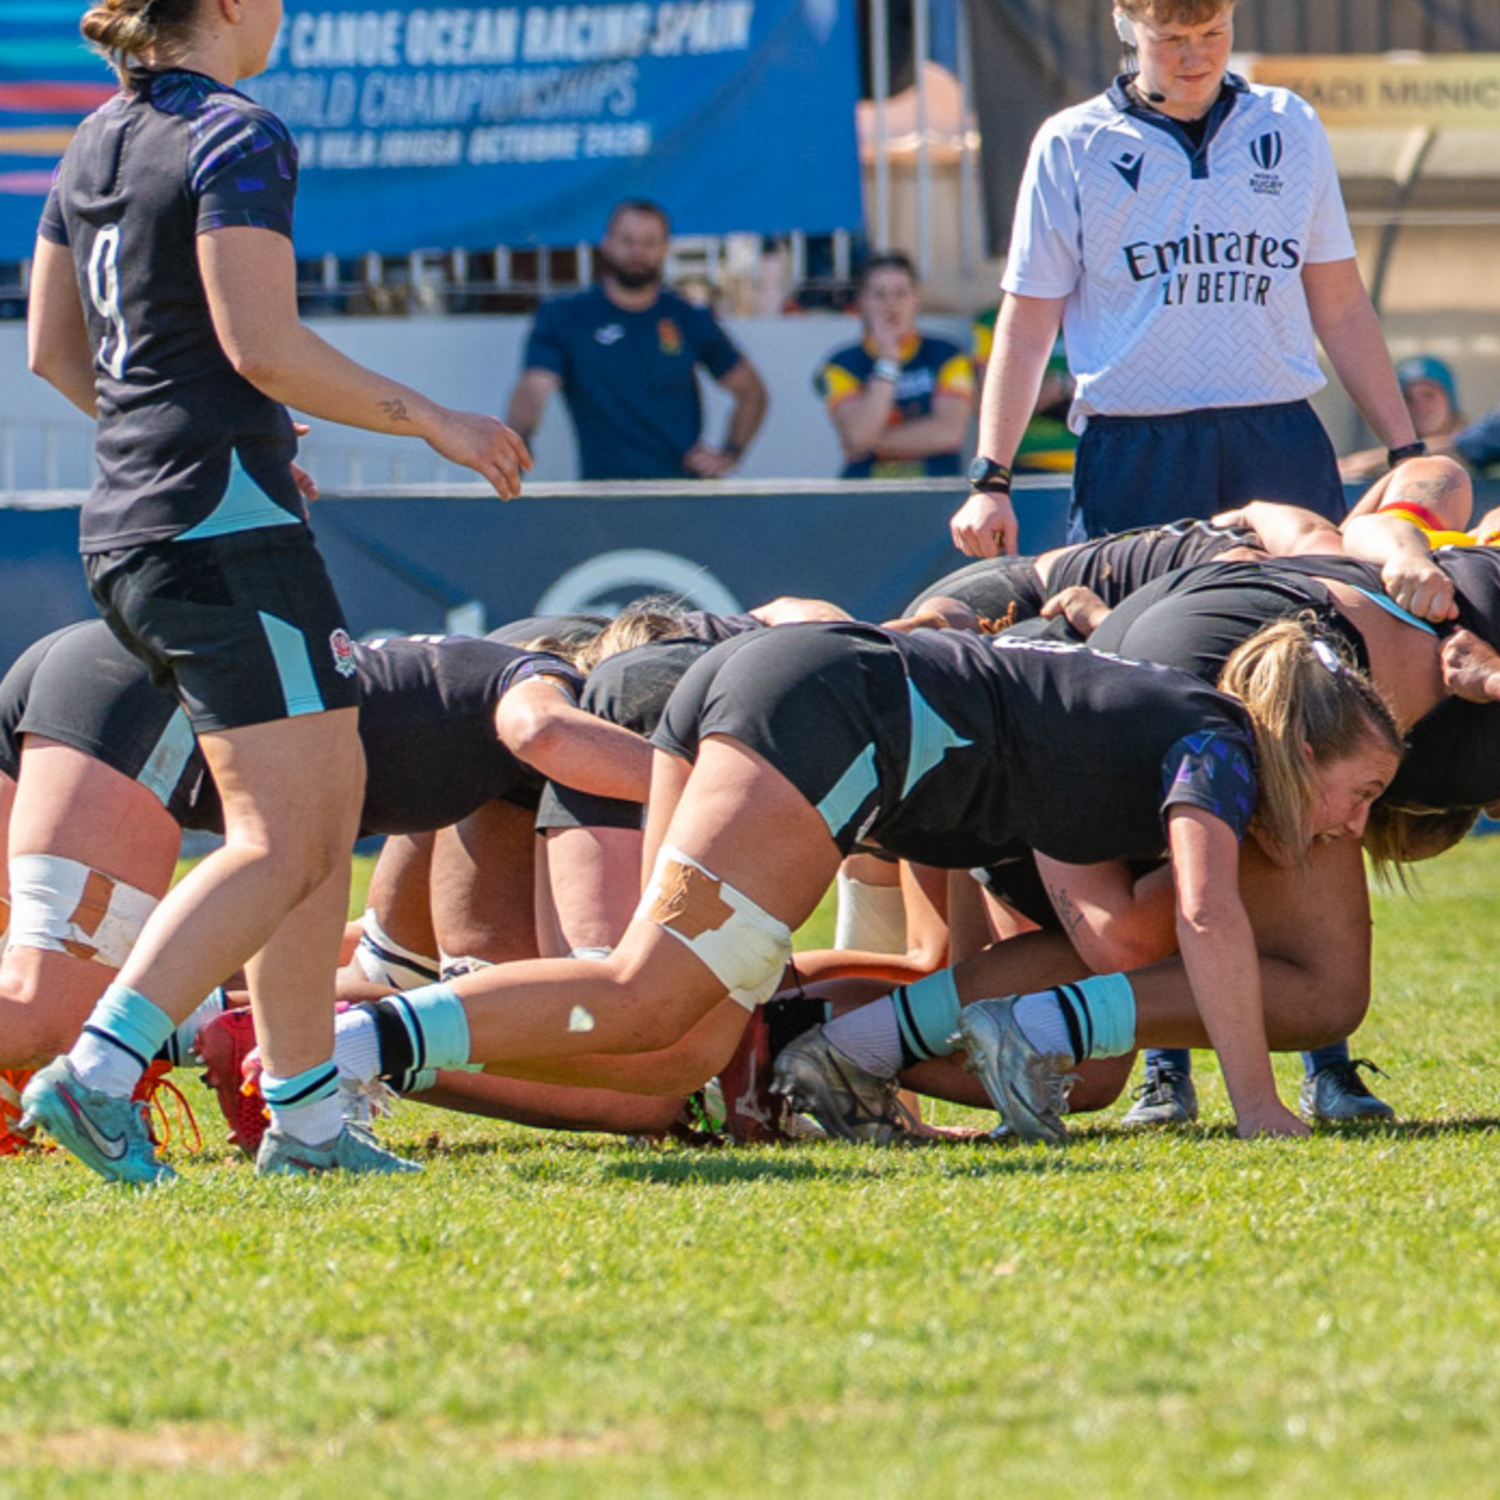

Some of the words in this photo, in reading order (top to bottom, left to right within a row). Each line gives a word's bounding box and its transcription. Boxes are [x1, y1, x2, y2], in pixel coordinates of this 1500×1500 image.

[289, 11, 400, 68] CANOE
[404, 8, 519, 67] OCEAN
[521, 1, 651, 63] RACING
[360, 59, 638, 128] CHAMPIONSHIPS
[1123, 223, 1300, 281] Emirates
[88, 226, 130, 381] 9
[1162, 272, 1189, 306] LY
